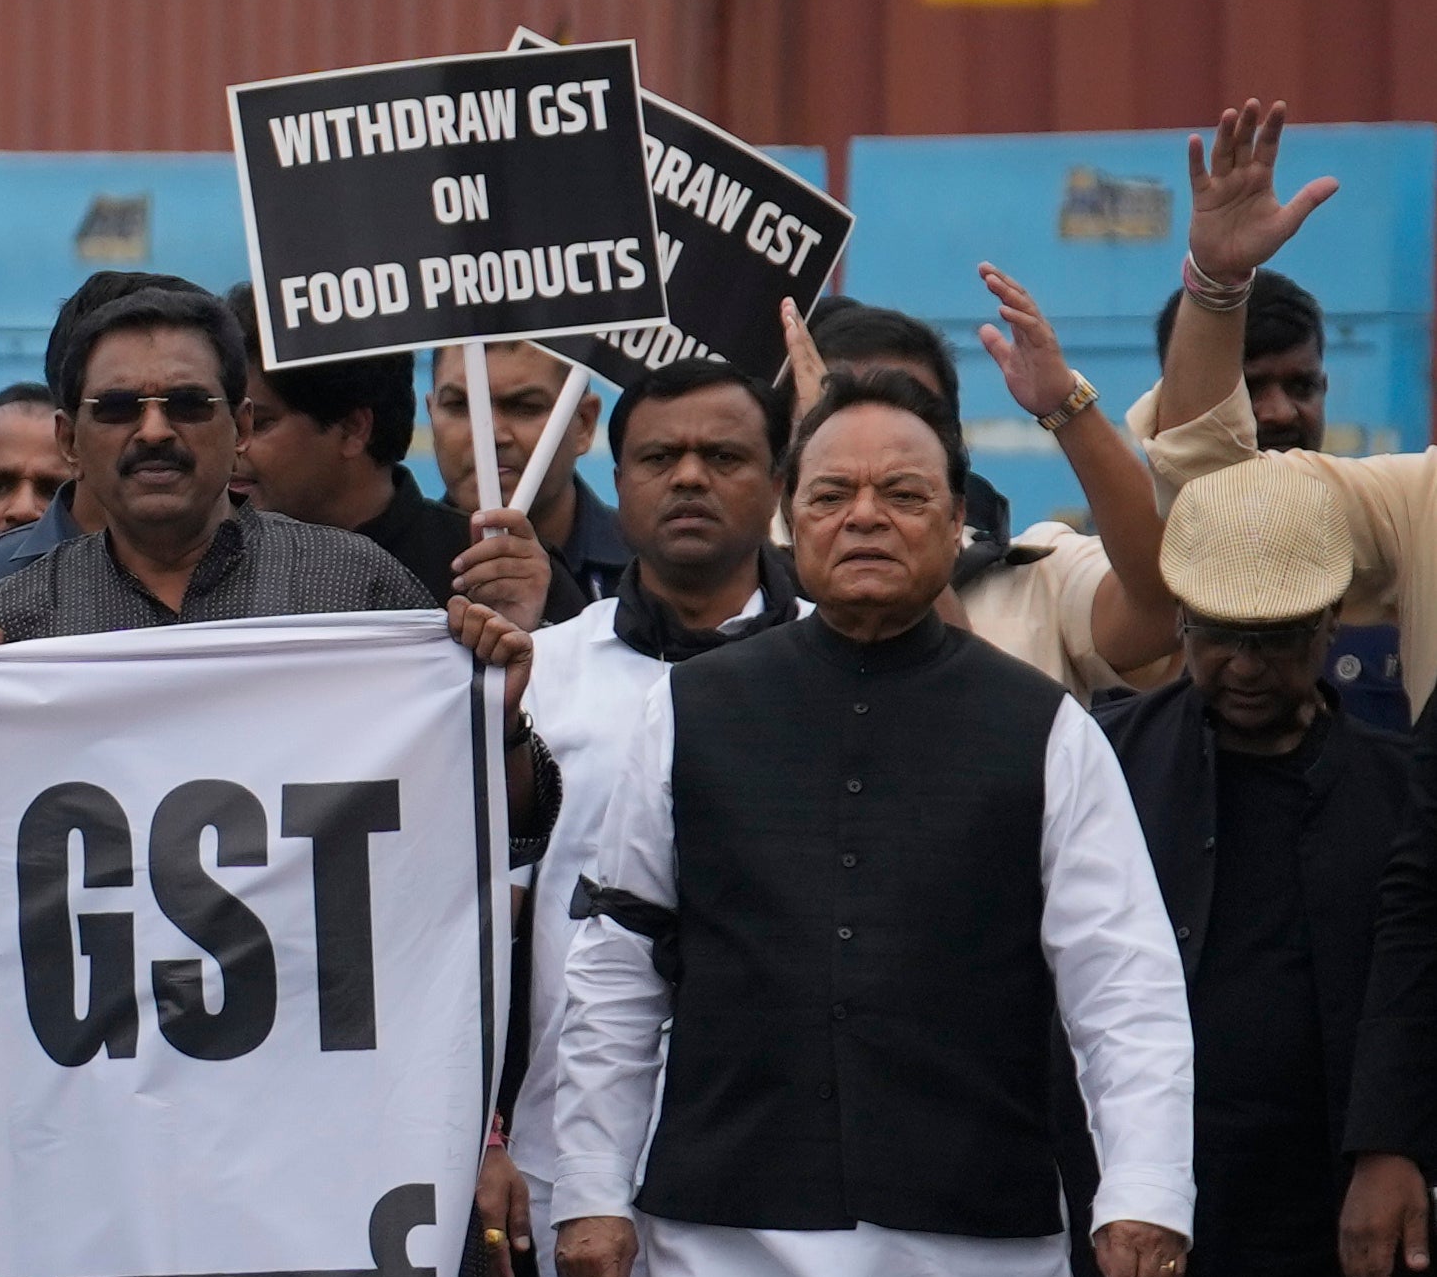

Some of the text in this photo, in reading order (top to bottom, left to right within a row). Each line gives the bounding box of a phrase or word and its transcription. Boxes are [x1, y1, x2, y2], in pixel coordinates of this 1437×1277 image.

[268, 78, 611, 169] WITHDRAW GST
[432, 174, 490, 224] ON
[746, 201, 823, 277] GST
[280, 237, 646, 329] FOOD PRODUCTS
[16, 779, 402, 1068] GST
